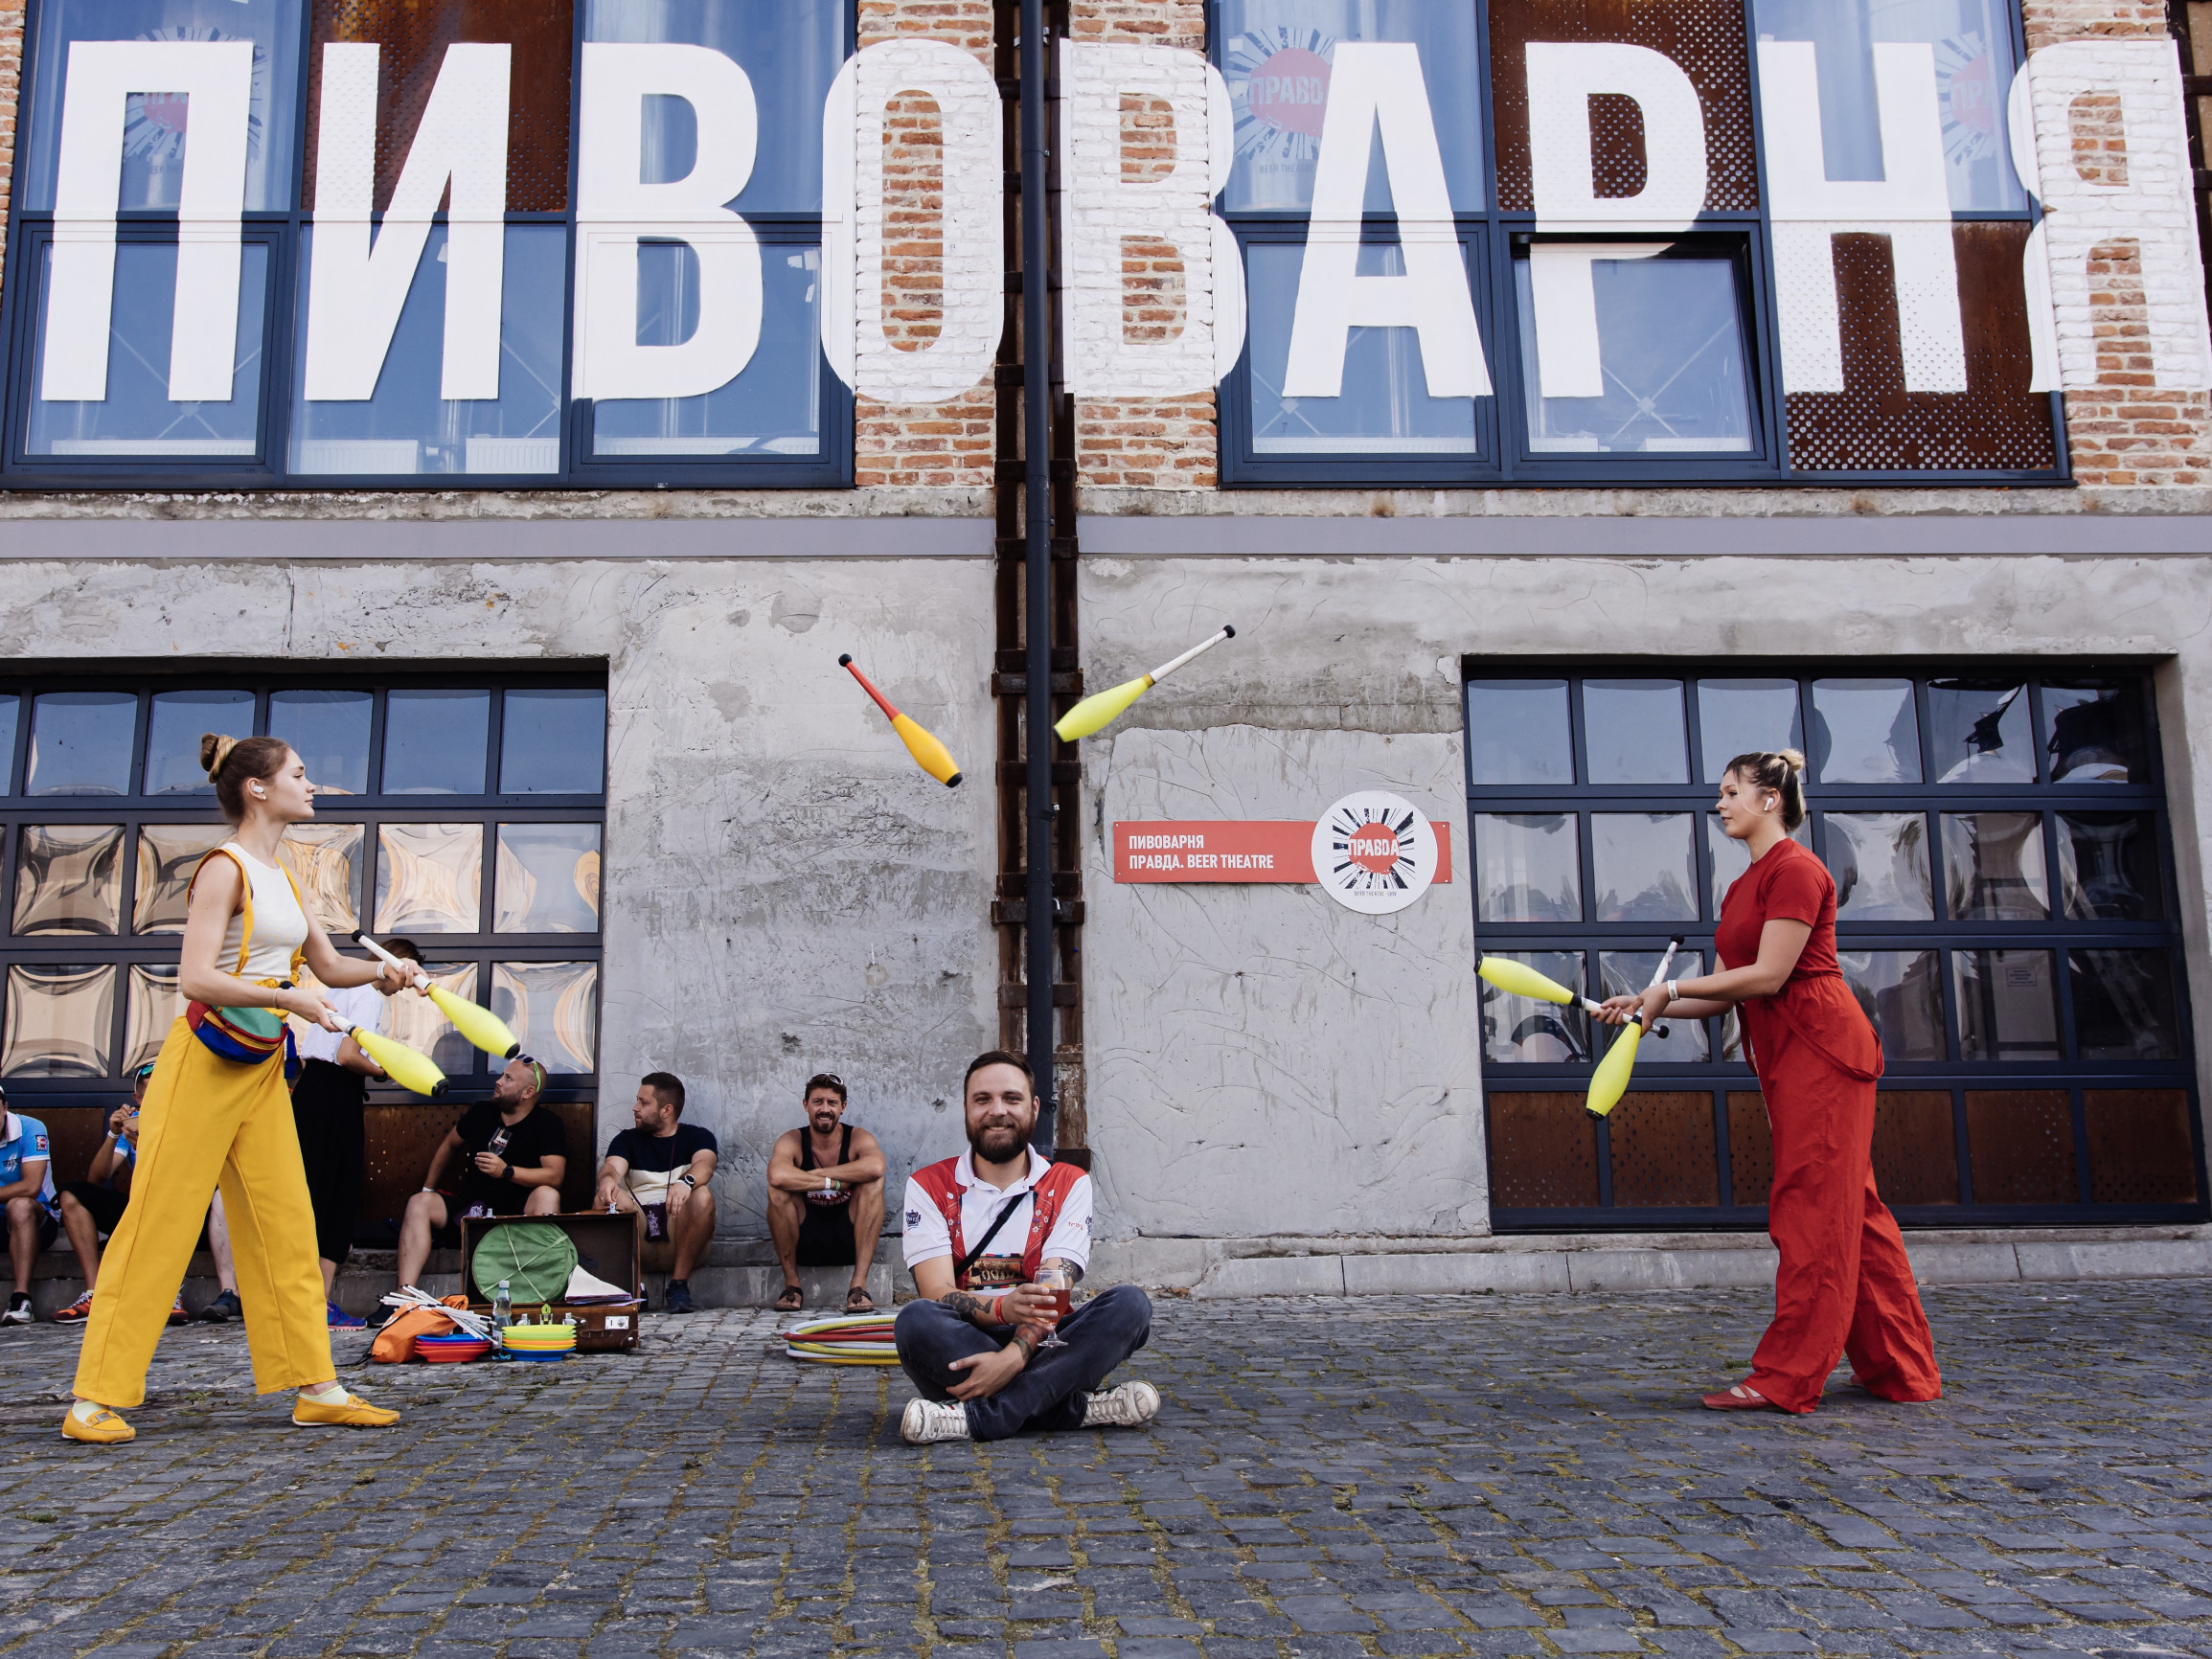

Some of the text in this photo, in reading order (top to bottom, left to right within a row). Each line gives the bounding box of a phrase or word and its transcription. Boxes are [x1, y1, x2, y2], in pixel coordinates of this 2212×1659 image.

[1129, 834, 1204, 850] ПИВОВАРНЯ
[1129, 853, 1274, 871] ПРАВДА. BEER THEATRE
